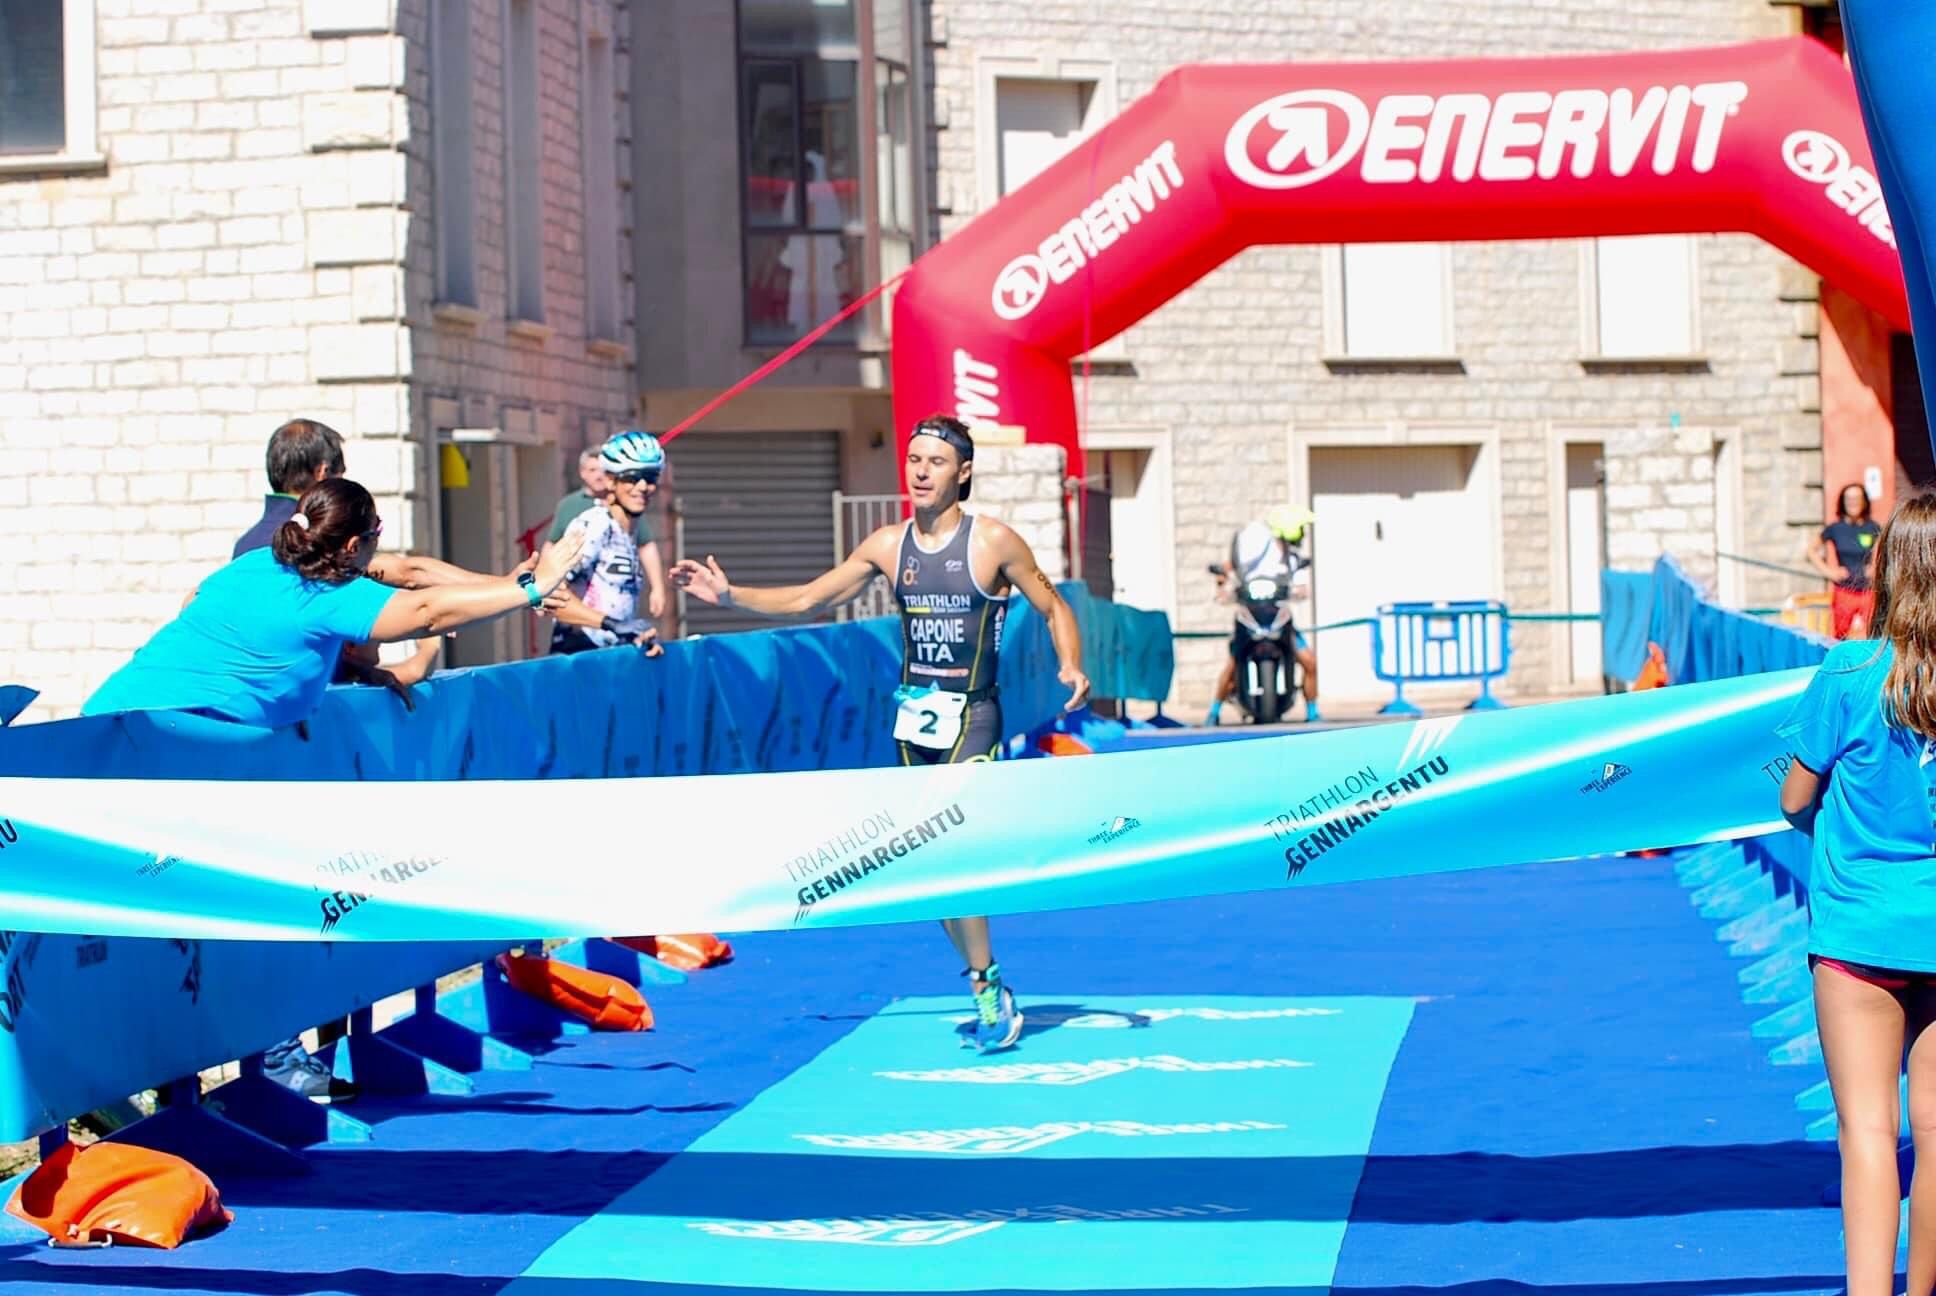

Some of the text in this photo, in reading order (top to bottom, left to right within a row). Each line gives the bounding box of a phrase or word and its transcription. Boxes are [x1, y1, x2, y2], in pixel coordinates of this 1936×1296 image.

[1360, 80, 1748, 184] ENERVIT
[1037, 140, 1184, 284] ENERVIT
[904, 594, 971, 608] TRIATHLON
[910, 618, 965, 643] CAPONE
[917, 643, 954, 663] ITA
[919, 710, 938, 735] 2
[1264, 765, 1379, 842] TRIATHLON
[1285, 755, 1450, 873] GENNARGENTU
[780, 809, 897, 883] TRIATHLON
[796, 803, 966, 910] GENNARGENTU
